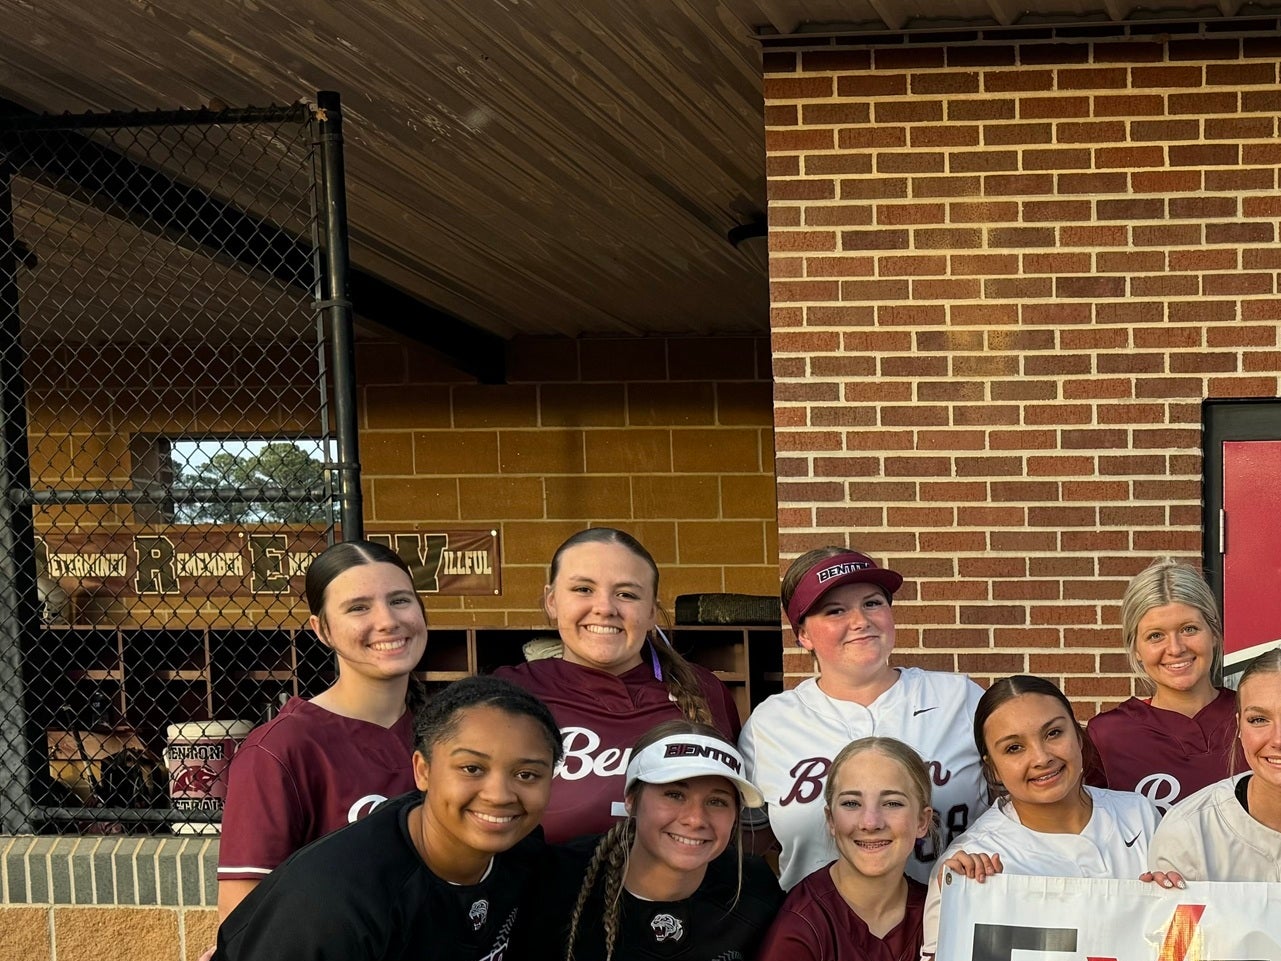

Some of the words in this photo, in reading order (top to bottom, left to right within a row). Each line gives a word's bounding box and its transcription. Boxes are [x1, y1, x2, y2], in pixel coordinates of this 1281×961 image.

[133, 536, 243, 594] REMEMBER
[171, 744, 224, 760] ENTON
[664, 743, 741, 775] BENTON
